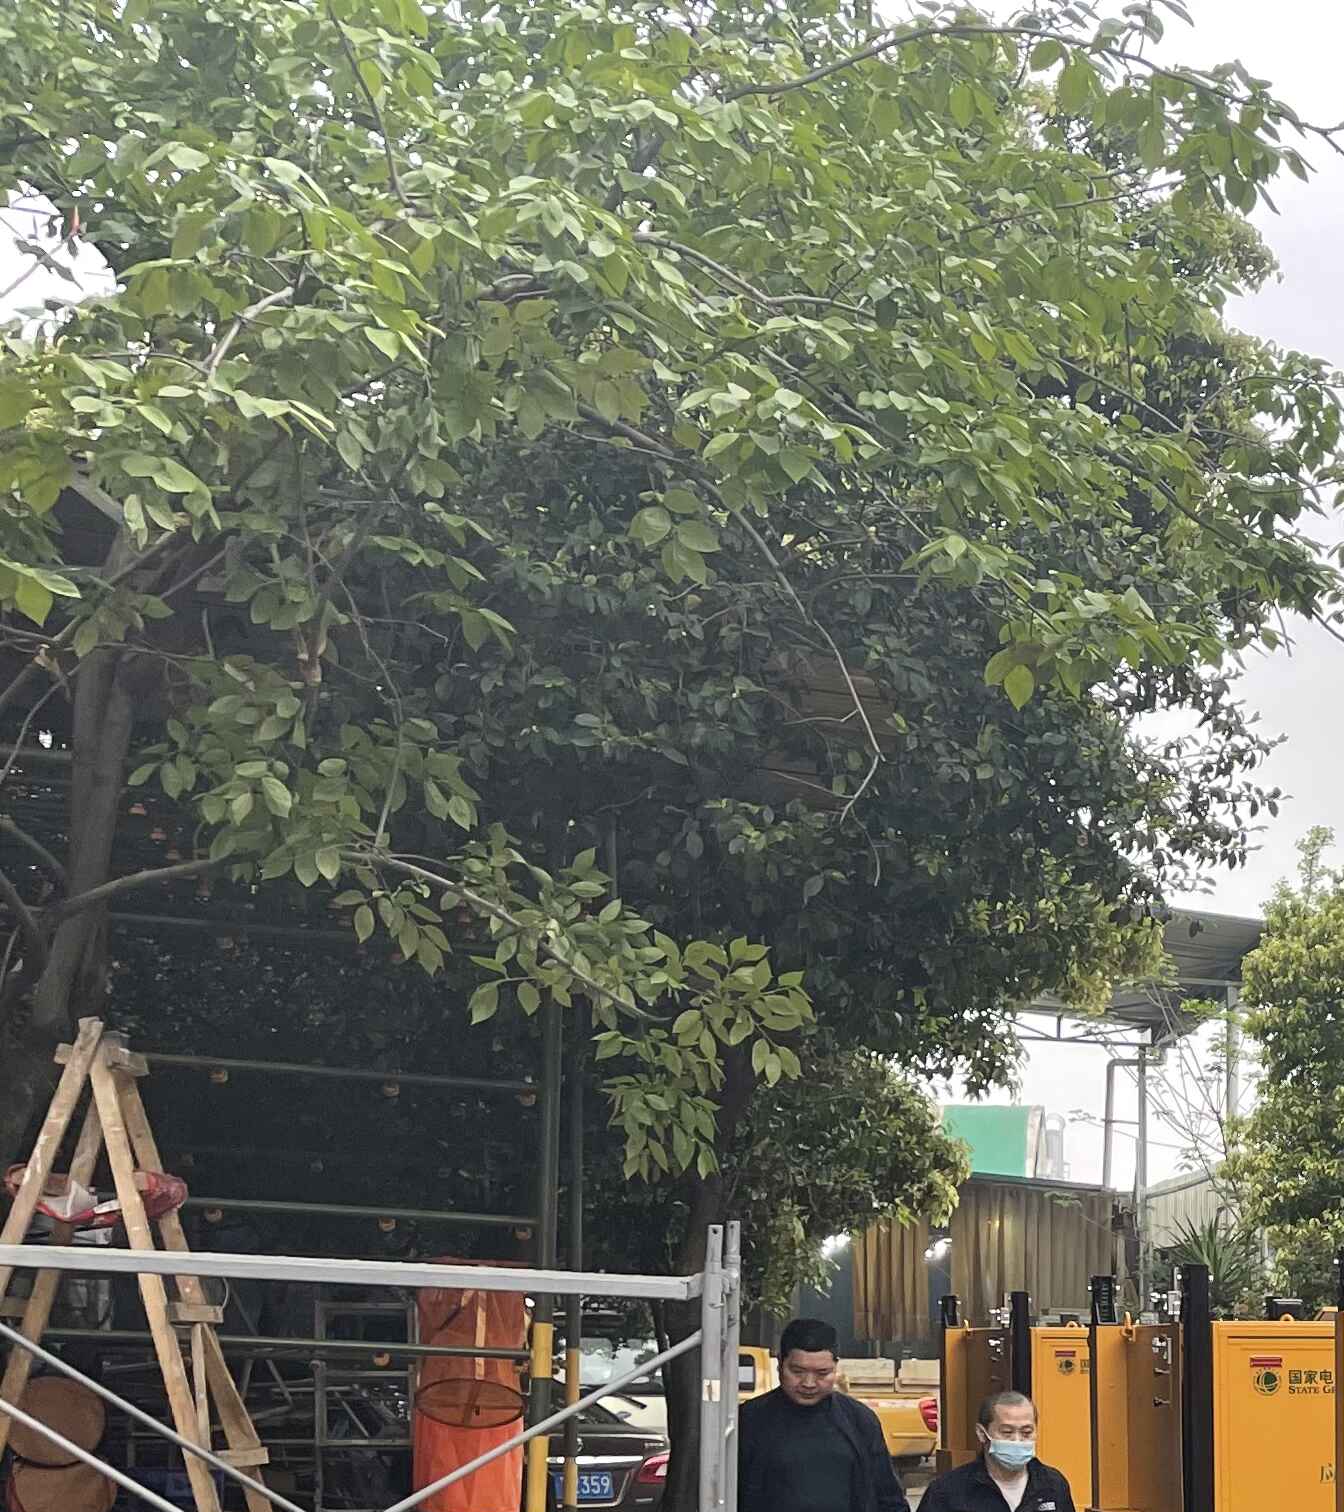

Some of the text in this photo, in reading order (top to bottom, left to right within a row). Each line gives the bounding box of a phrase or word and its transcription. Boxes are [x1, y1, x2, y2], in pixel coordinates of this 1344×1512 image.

[1288, 1369, 1334, 1384] 国家电
[576, 1475, 610, 1494] 359
